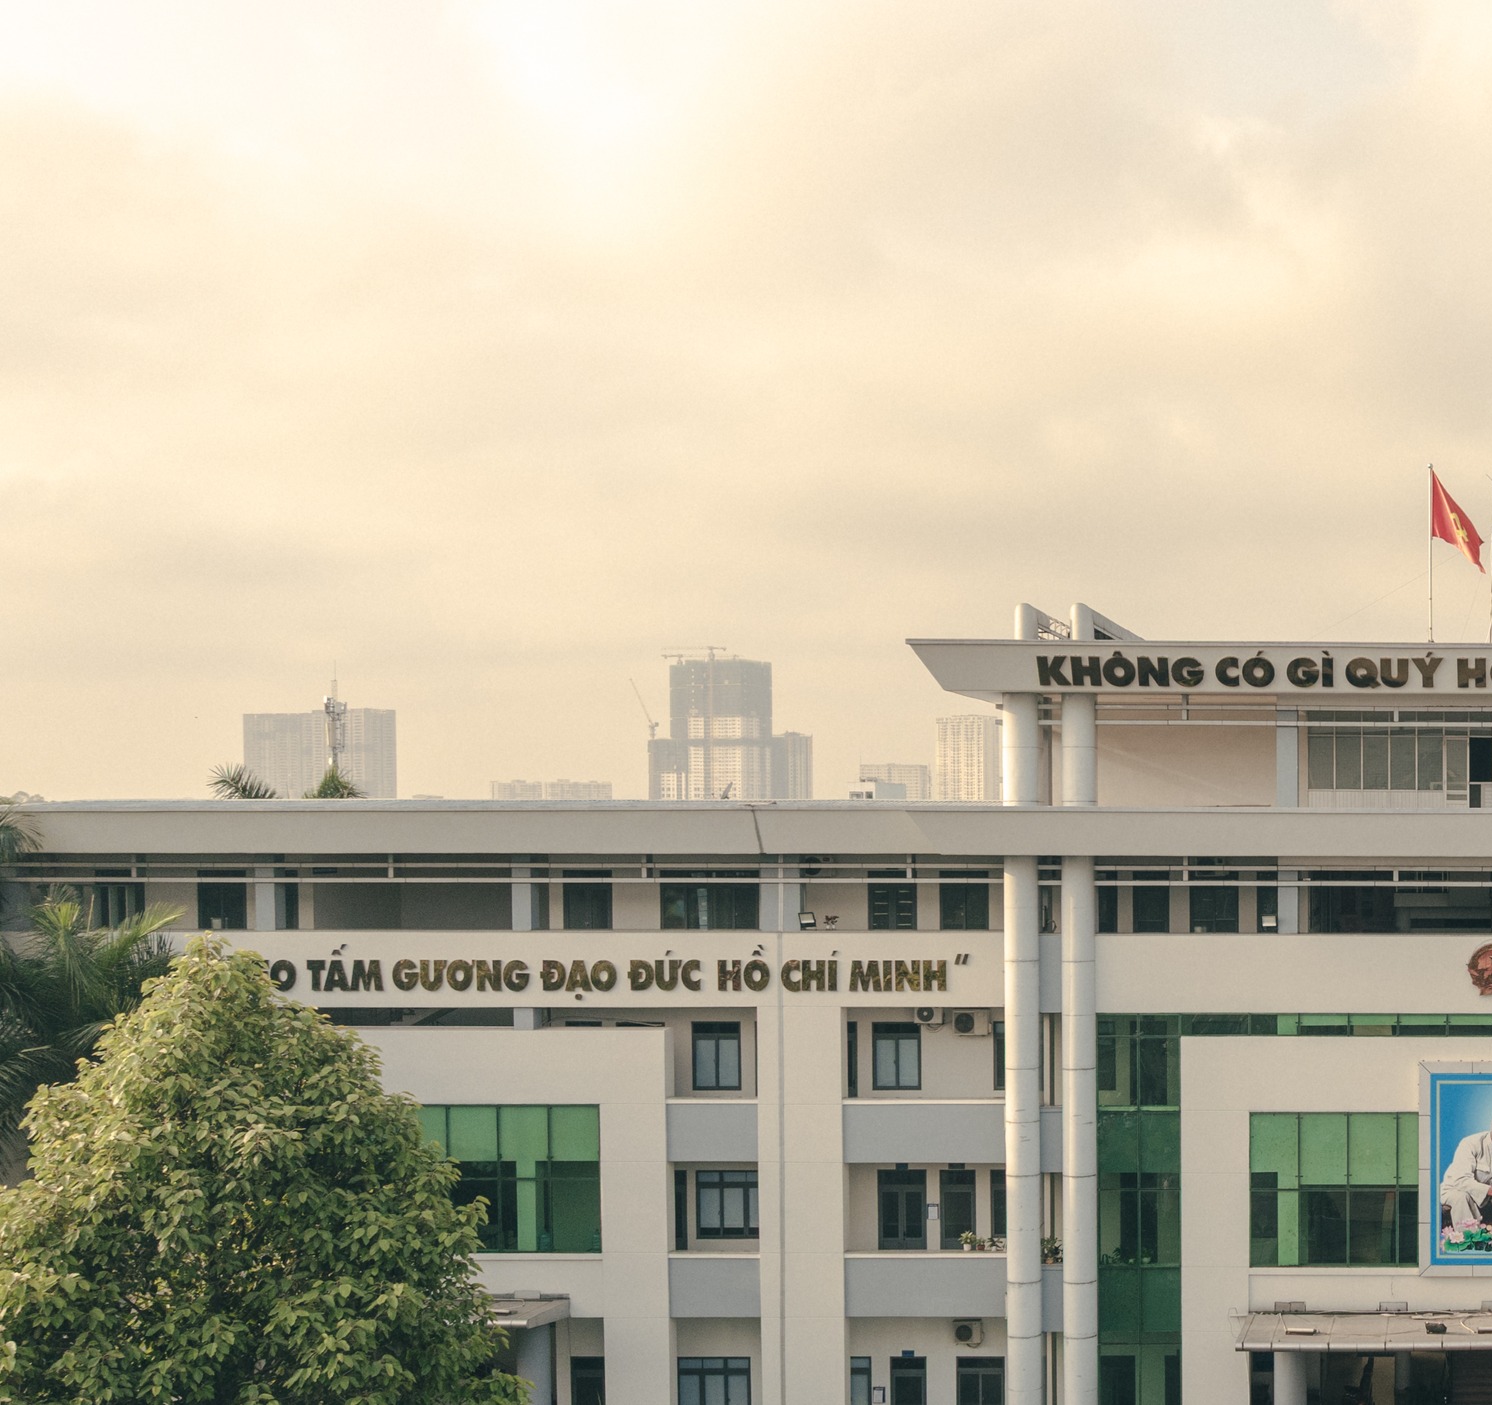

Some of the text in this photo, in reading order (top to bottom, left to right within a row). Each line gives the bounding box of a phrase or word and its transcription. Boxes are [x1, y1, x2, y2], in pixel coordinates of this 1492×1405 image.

[1036, 651, 1204, 687] KHÔNG
[1215, 651, 1275, 688] CÓ
[1287, 651, 1334, 688] GÌ
[1345, 652, 1443, 688] QUÝ
[306, 944, 384, 992] TẤM
[392, 959, 530, 992] GƯƠNG
[540, 959, 617, 1001] ĐẠO
[627, 950, 702, 992] ĐỨC
[717, 945, 770, 992] HỒ
[781, 950, 838, 992] CHÍ
